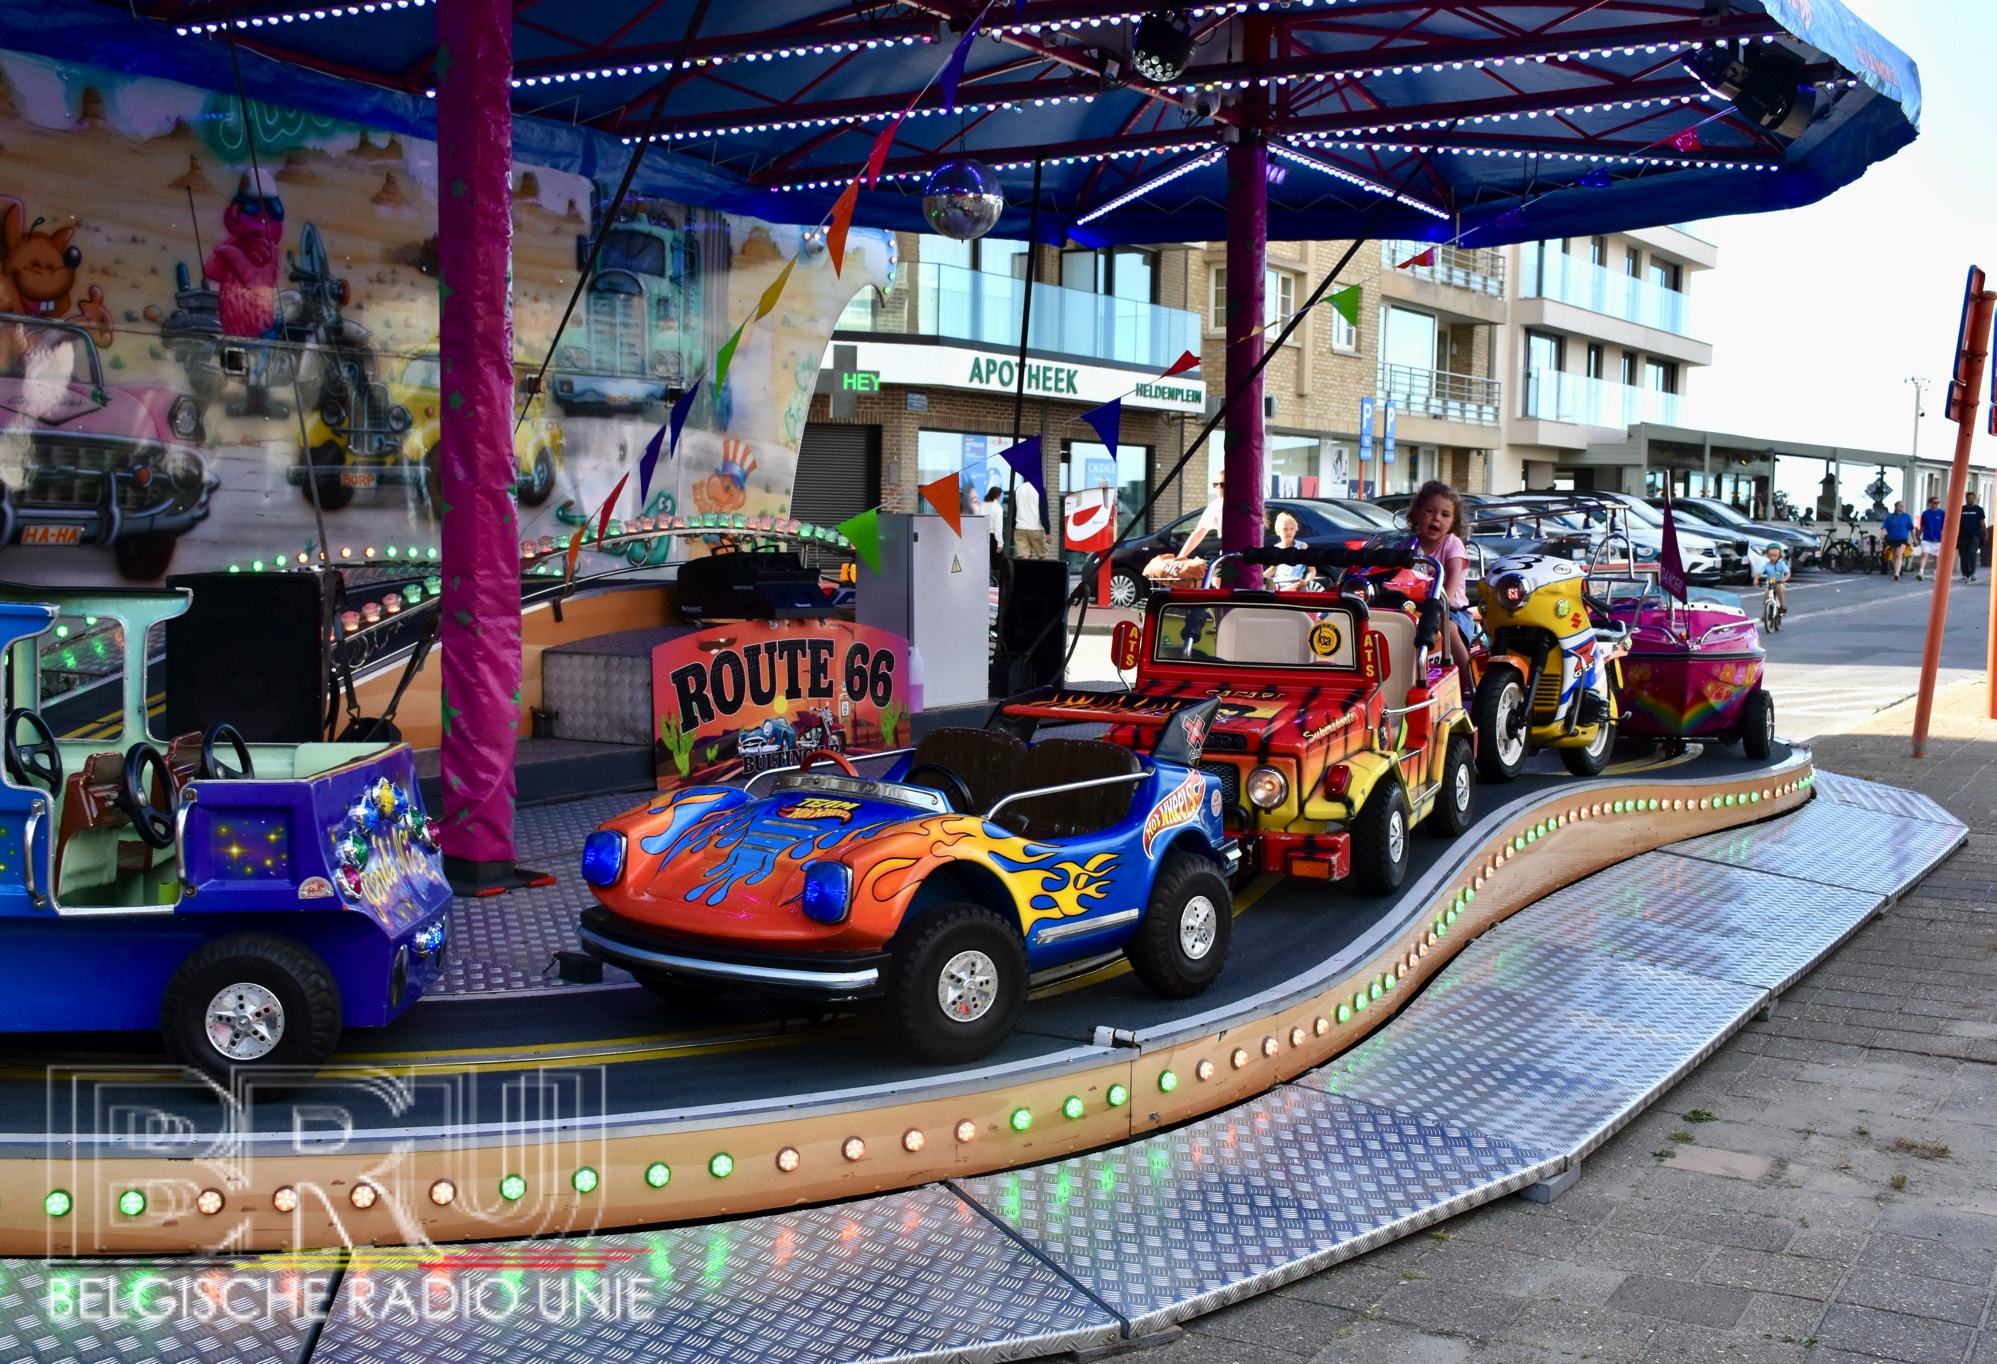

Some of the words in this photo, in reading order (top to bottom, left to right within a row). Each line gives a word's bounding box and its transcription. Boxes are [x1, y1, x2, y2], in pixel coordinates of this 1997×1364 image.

[843, 372, 880, 391] HEY
[1135, 382, 1202, 403] HELDENPLEIN
[1363, 403, 1372, 429] P
[1386, 407, 1395, 432] P
[342, 473, 374, 486] BURP
[23, 527, 79, 543] HA-HA
[1125, 626, 1139, 667] ATS
[1363, 634, 1376, 677] ATS
[670, 638, 835, 735] ROUTE
[844, 641, 895, 708] 66
[797, 798, 861, 810] TEAM
[1145, 814, 1161, 840] HOT
[1159, 782, 1198, 827] WHEELS
